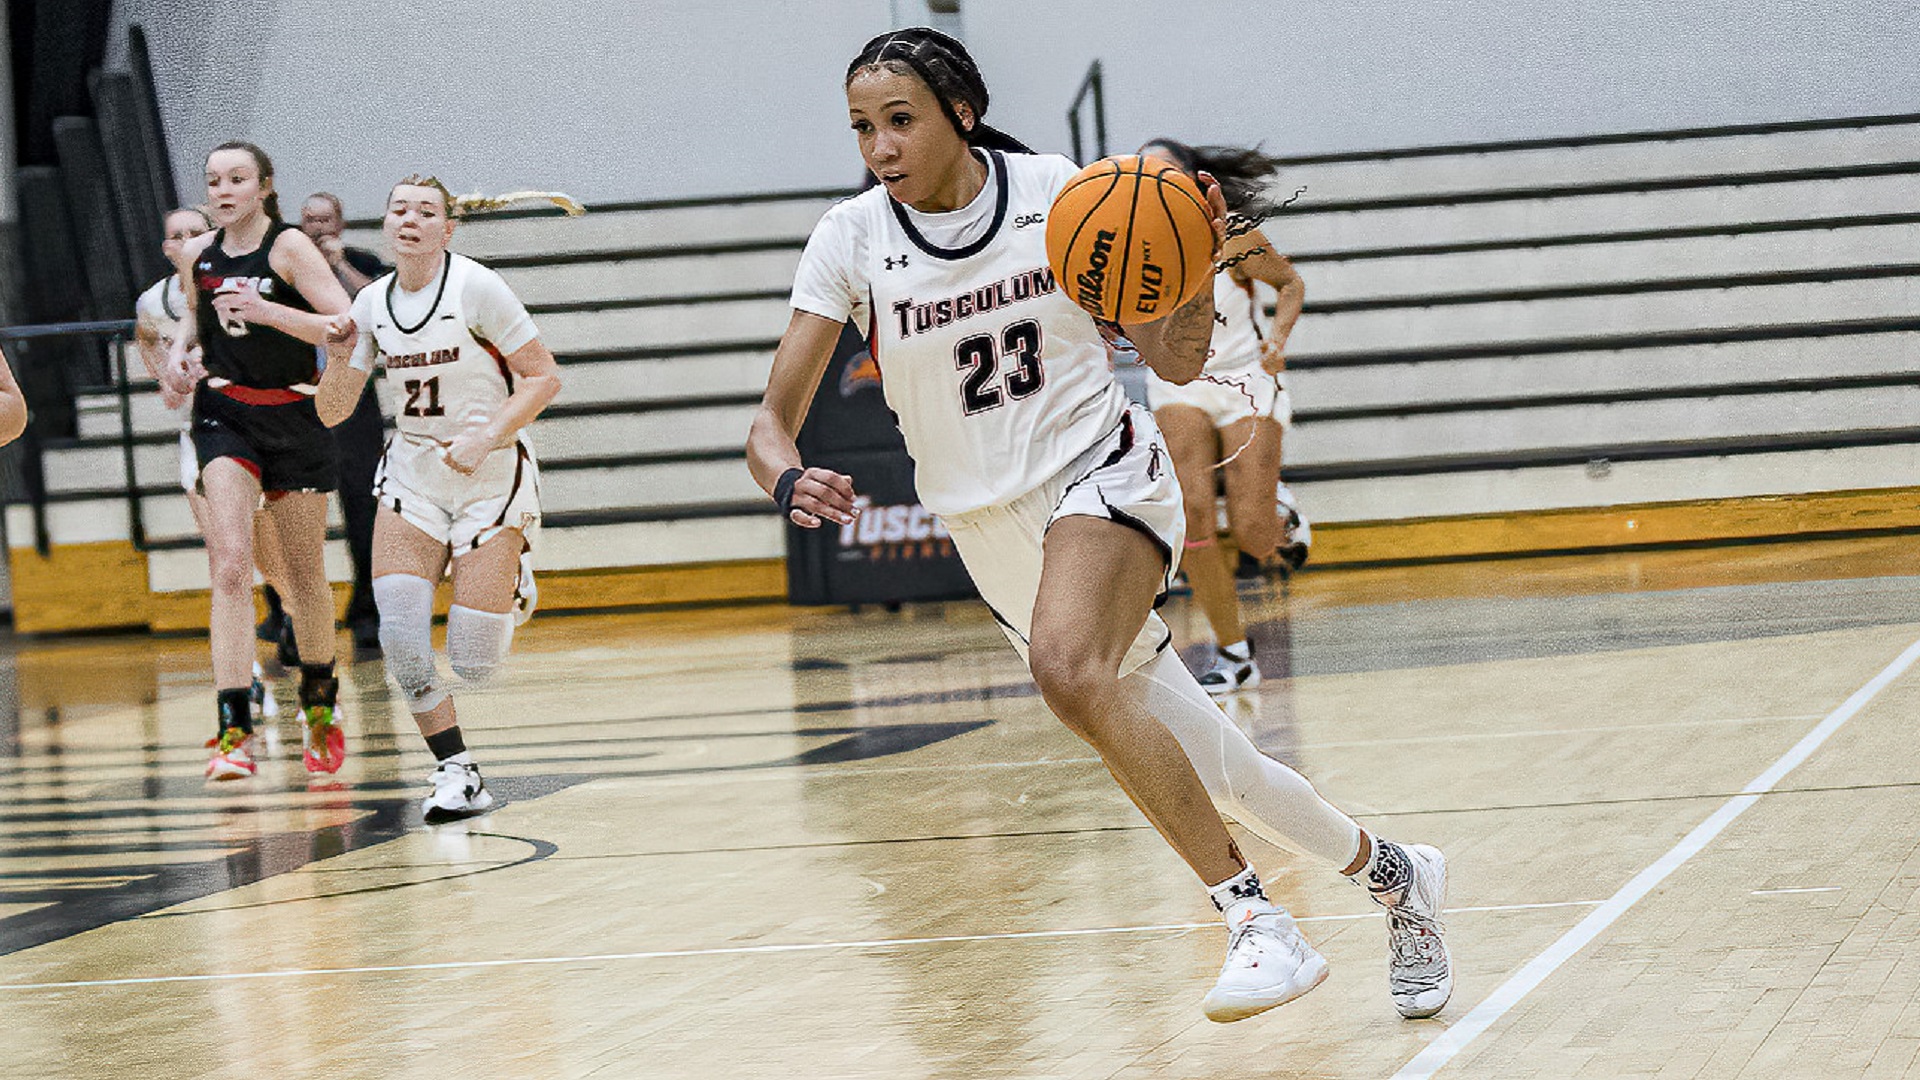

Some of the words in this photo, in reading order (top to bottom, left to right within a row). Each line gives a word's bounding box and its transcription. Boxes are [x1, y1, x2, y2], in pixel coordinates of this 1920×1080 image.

[1014, 213, 1045, 229] SAC
[1077, 229, 1117, 317] Wilson
[1136, 263, 1163, 314] EVO
[954, 317, 1044, 417] 23
[404, 376, 445, 417] 21
